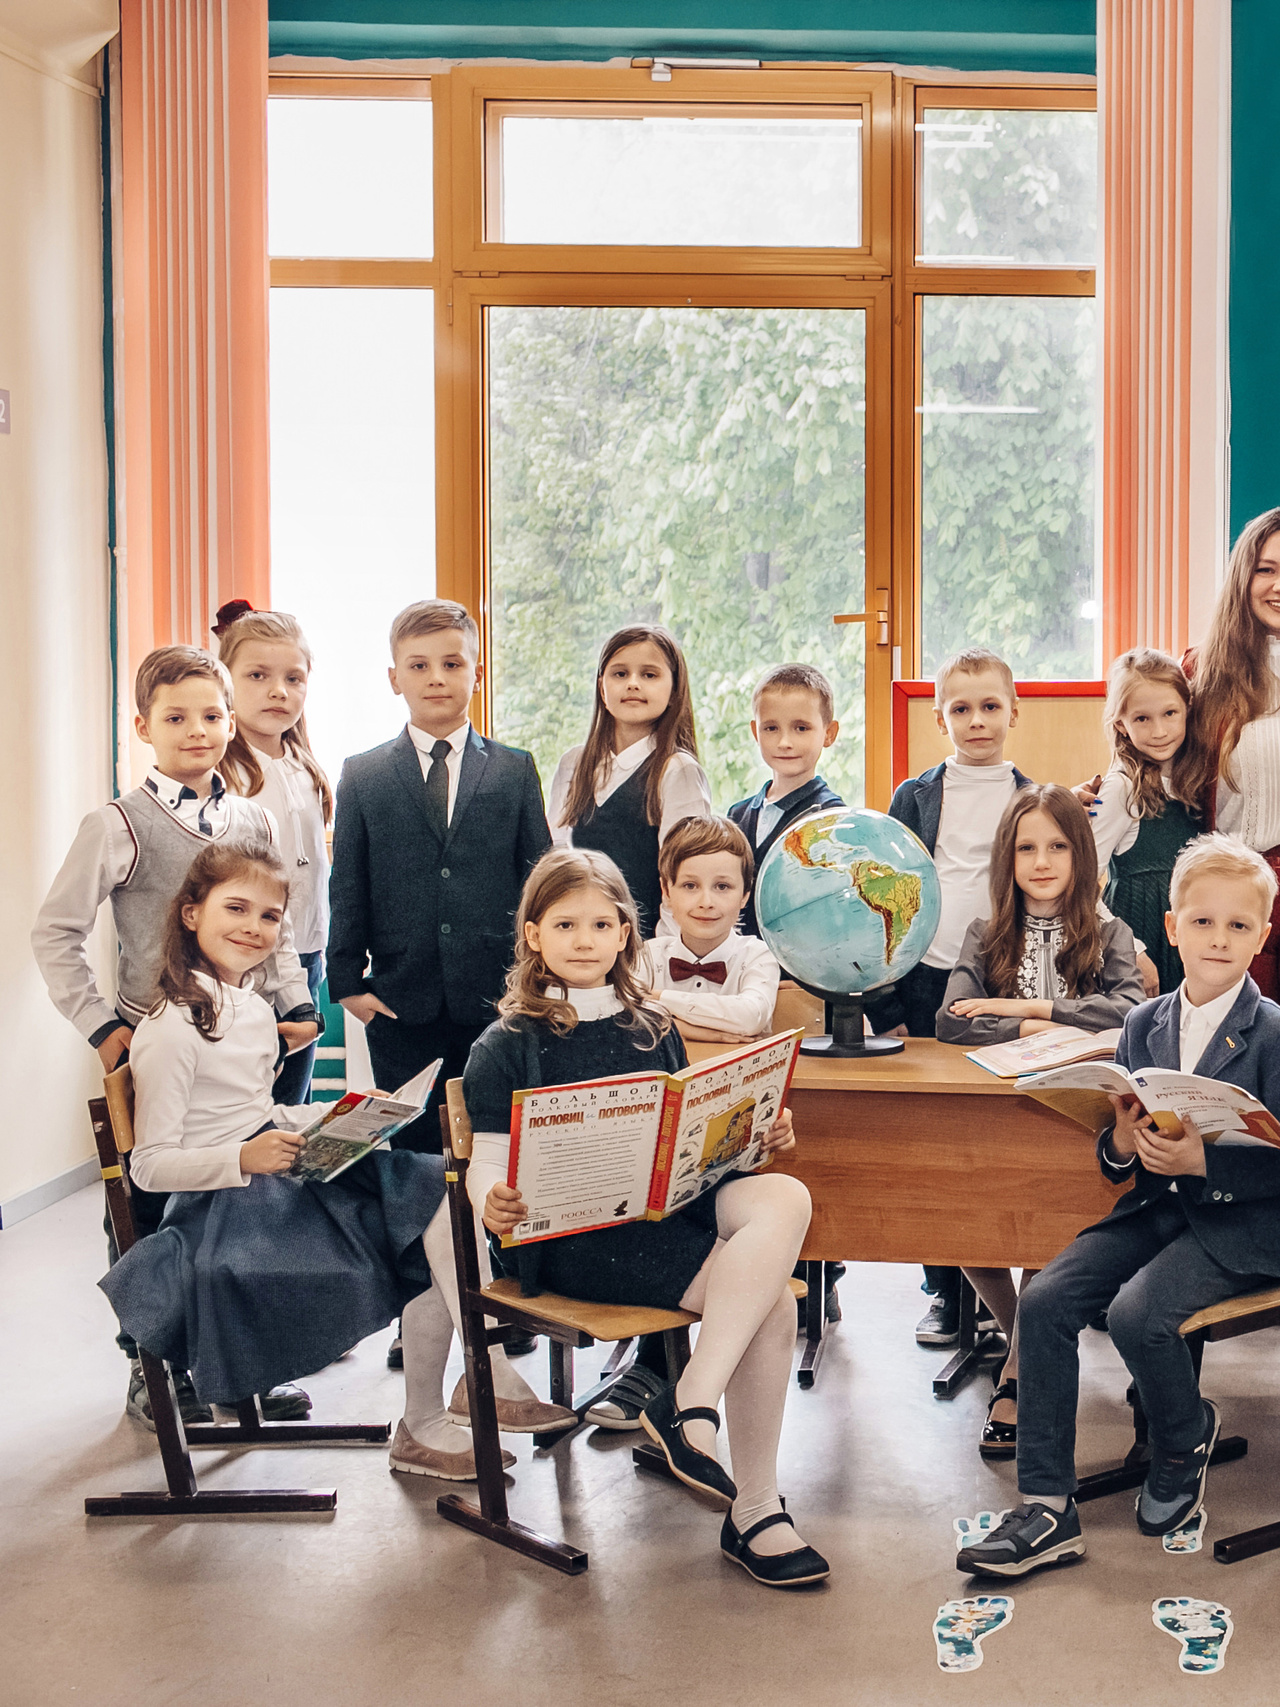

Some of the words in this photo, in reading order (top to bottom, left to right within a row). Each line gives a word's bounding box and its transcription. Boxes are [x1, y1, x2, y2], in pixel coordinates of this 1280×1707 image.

[690, 1042, 791, 1090] БОЛЬШОЙ
[531, 1084, 658, 1107] БОЛЬШОЙ
[686, 1083, 731, 1110] ПОСЛОВИЦ
[742, 1057, 788, 1086] ПОГОВОРОК
[528, 1111, 585, 1129] ПОСЛОВИЦ
[598, 1102, 657, 1120] ПОГОВОРОК
[531, 1101, 597, 1113] ТОЛКОВЫЙ
[605, 1094, 658, 1104] СЛОВАРЬ
[560, 1207, 603, 1220] РООССА
